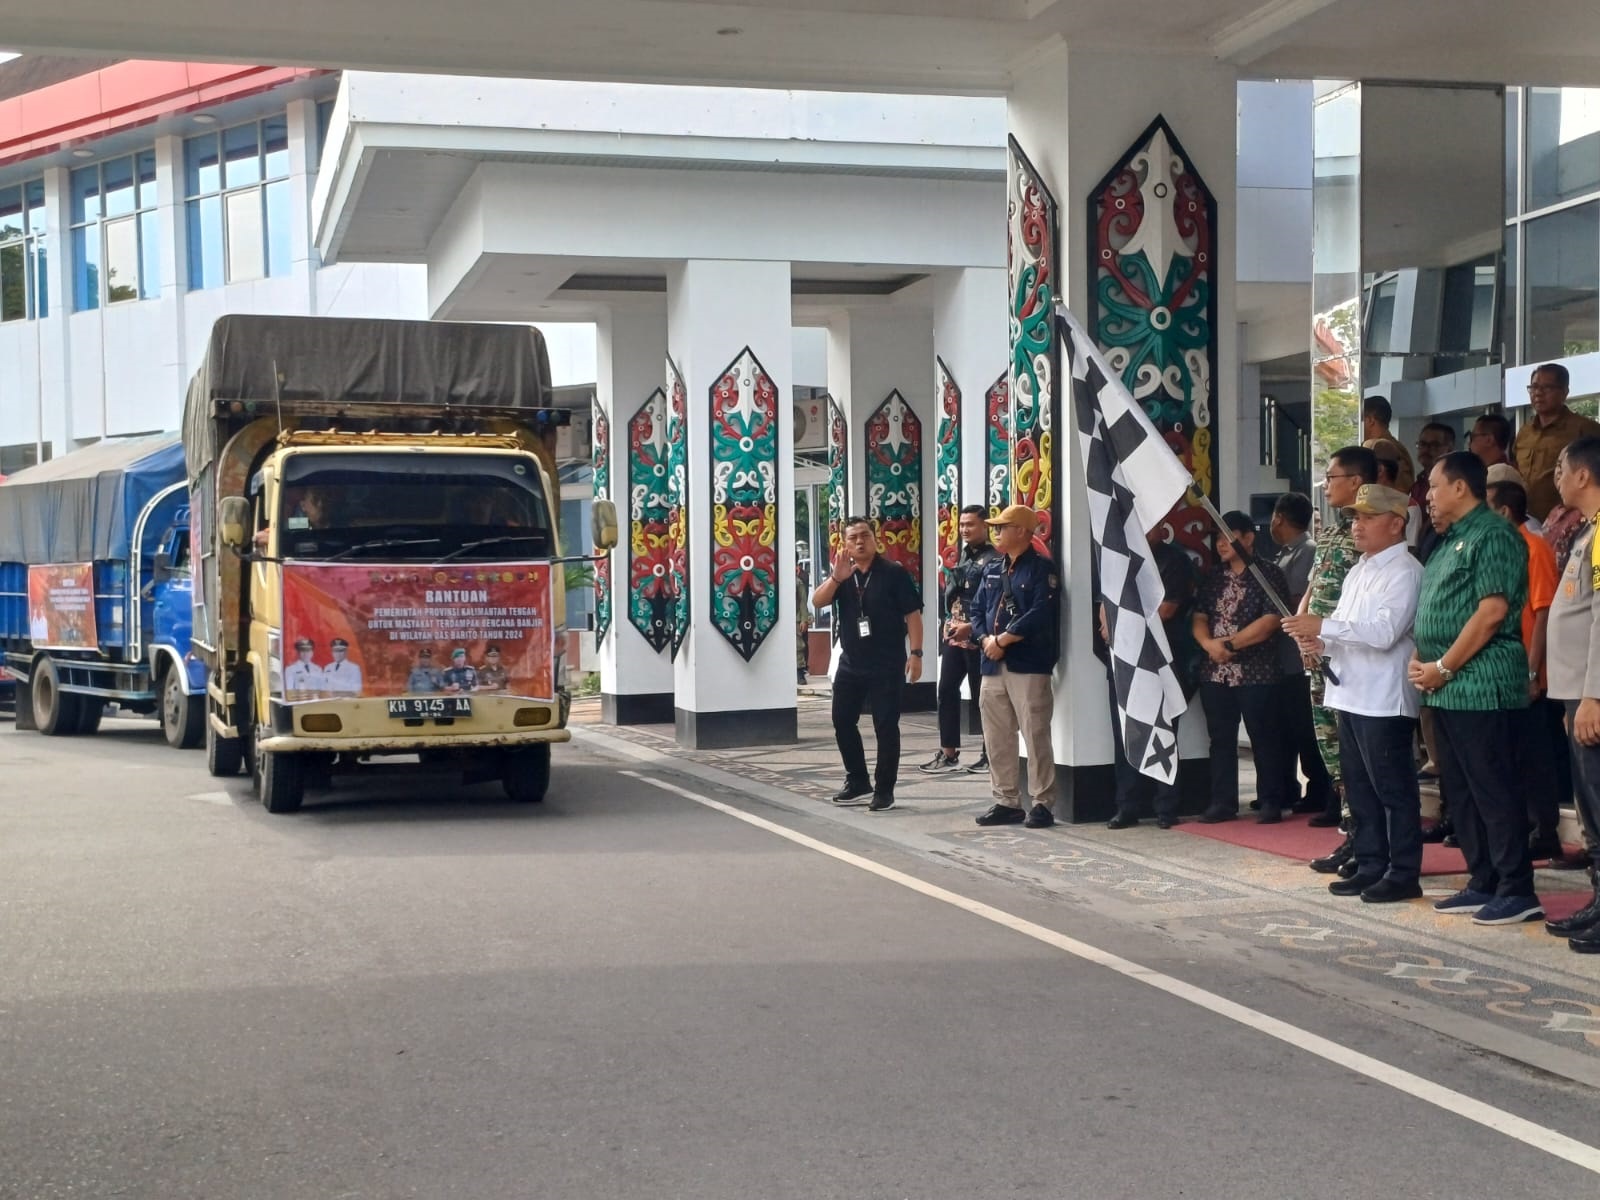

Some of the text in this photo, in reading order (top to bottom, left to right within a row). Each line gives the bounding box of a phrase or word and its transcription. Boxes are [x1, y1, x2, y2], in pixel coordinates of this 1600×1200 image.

[425, 590, 487, 603] BANTUAN
[374, 606, 537, 617] PEMERINTAH PROVINSI KALIMANTAN TENGAH
[368, 619, 392, 629] UNTUK
[437, 618, 479, 628] TERDAMPAK
[516, 618, 544, 628] BANJIR
[389, 630, 524, 641] DI WILAYAH DAS BARITO TAHUN 2024
[389, 698, 471, 713] KH 9145 AA
